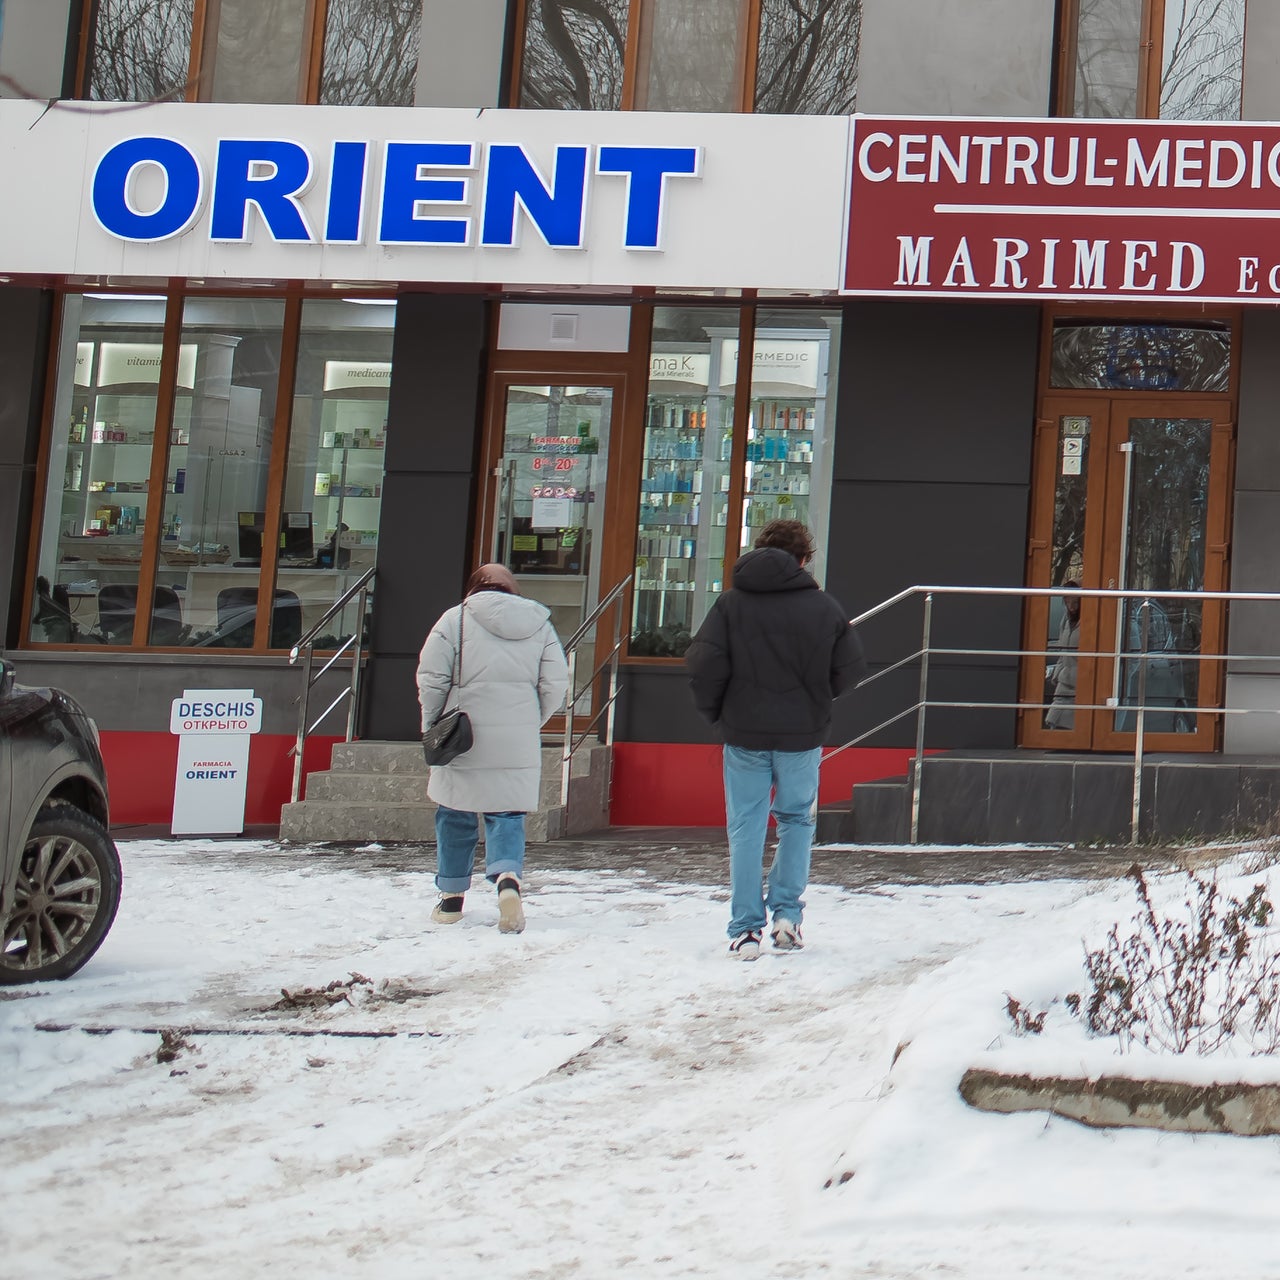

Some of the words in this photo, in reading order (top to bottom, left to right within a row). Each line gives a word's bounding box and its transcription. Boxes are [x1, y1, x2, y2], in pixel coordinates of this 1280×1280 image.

[90, 136, 704, 252] ORIENT
[893, 236, 1206, 291] MARIMED
[127, 356, 161, 366] vitami
[347, 368, 392, 378] medicam
[534, 436, 582, 445] FARMACIE
[179, 702, 255, 717] DESCHIS
[183, 720, 248, 730] ОТКРЫТО
[186, 770, 237, 779] ORIENT
